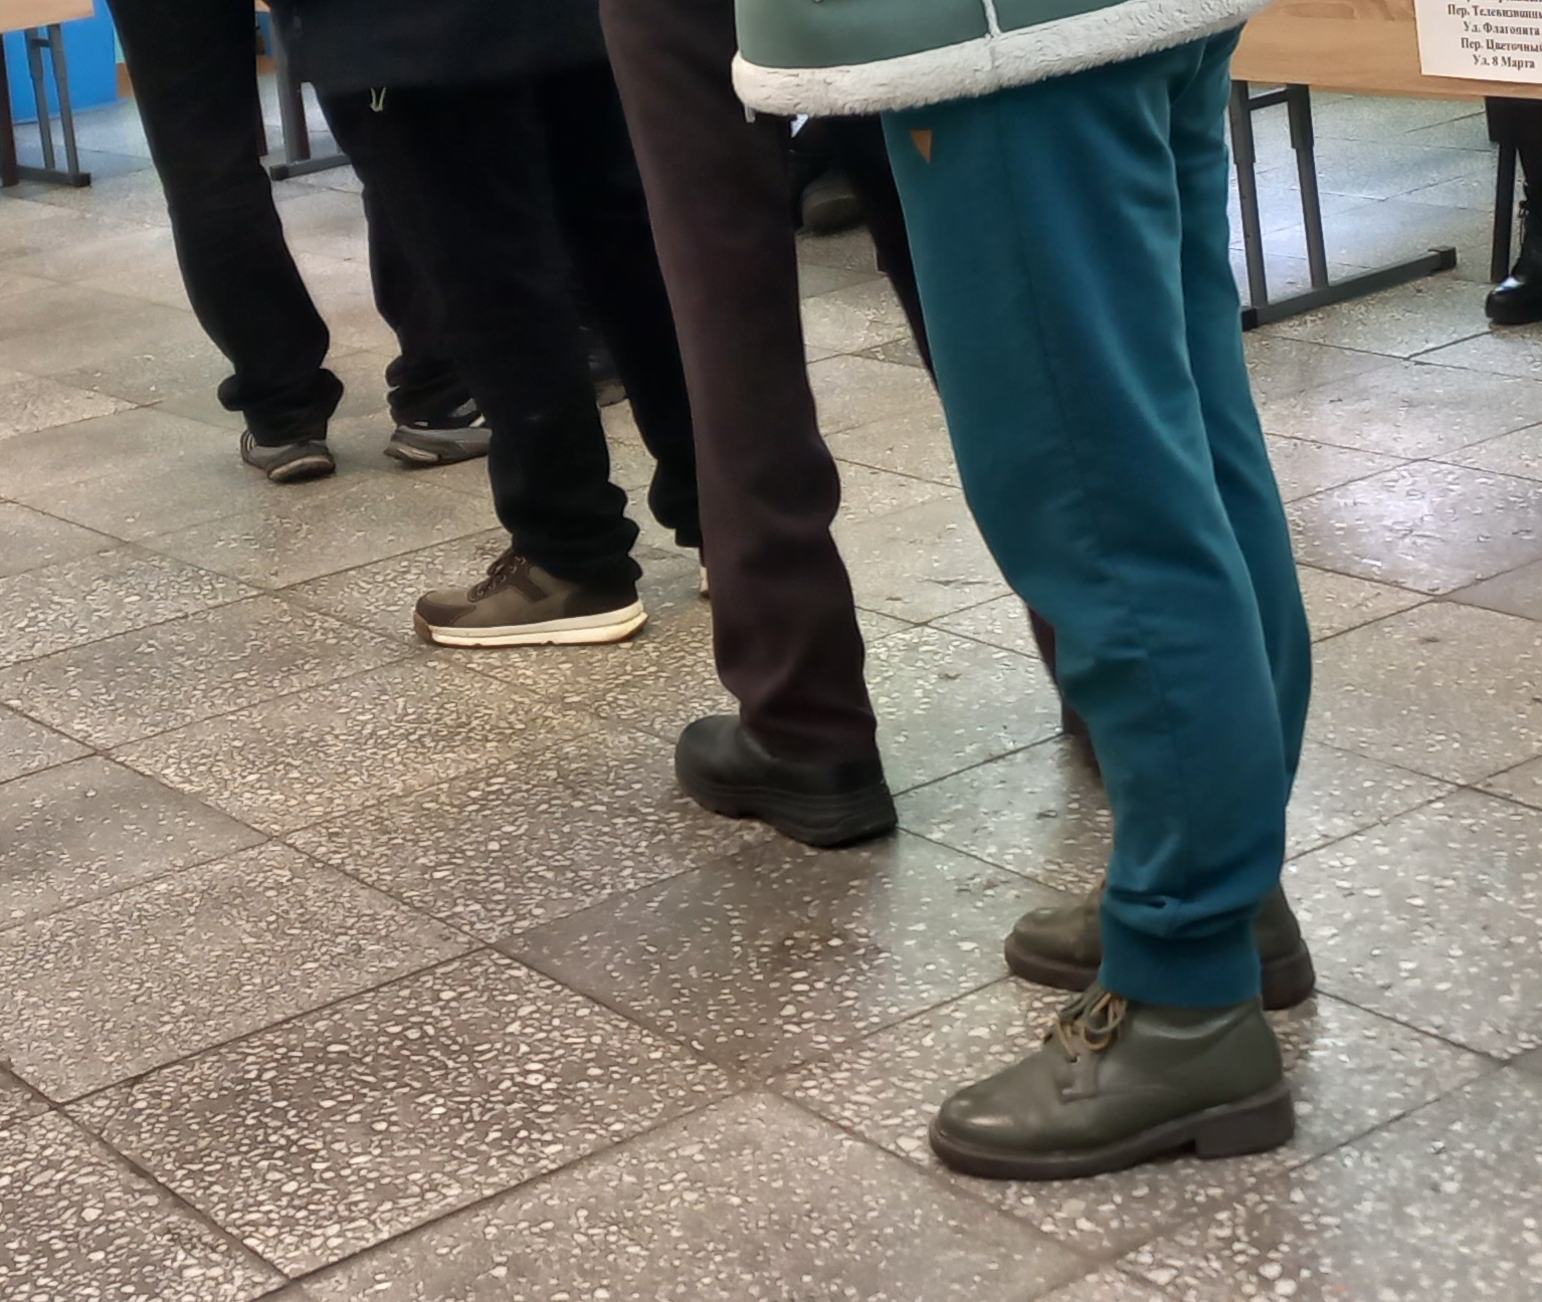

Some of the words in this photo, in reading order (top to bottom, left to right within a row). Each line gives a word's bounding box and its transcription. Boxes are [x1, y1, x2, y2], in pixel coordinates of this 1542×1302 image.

[1448, 4, 1470, 17] Пер.
[1463, 21, 1481, 33] Ул.
[1461, 38, 1483, 51] Пер.
[1473, 54, 1489, 66] Ул.
[1492, 56, 1498, 66] 8
[1501, 56, 1535, 70] Марта
